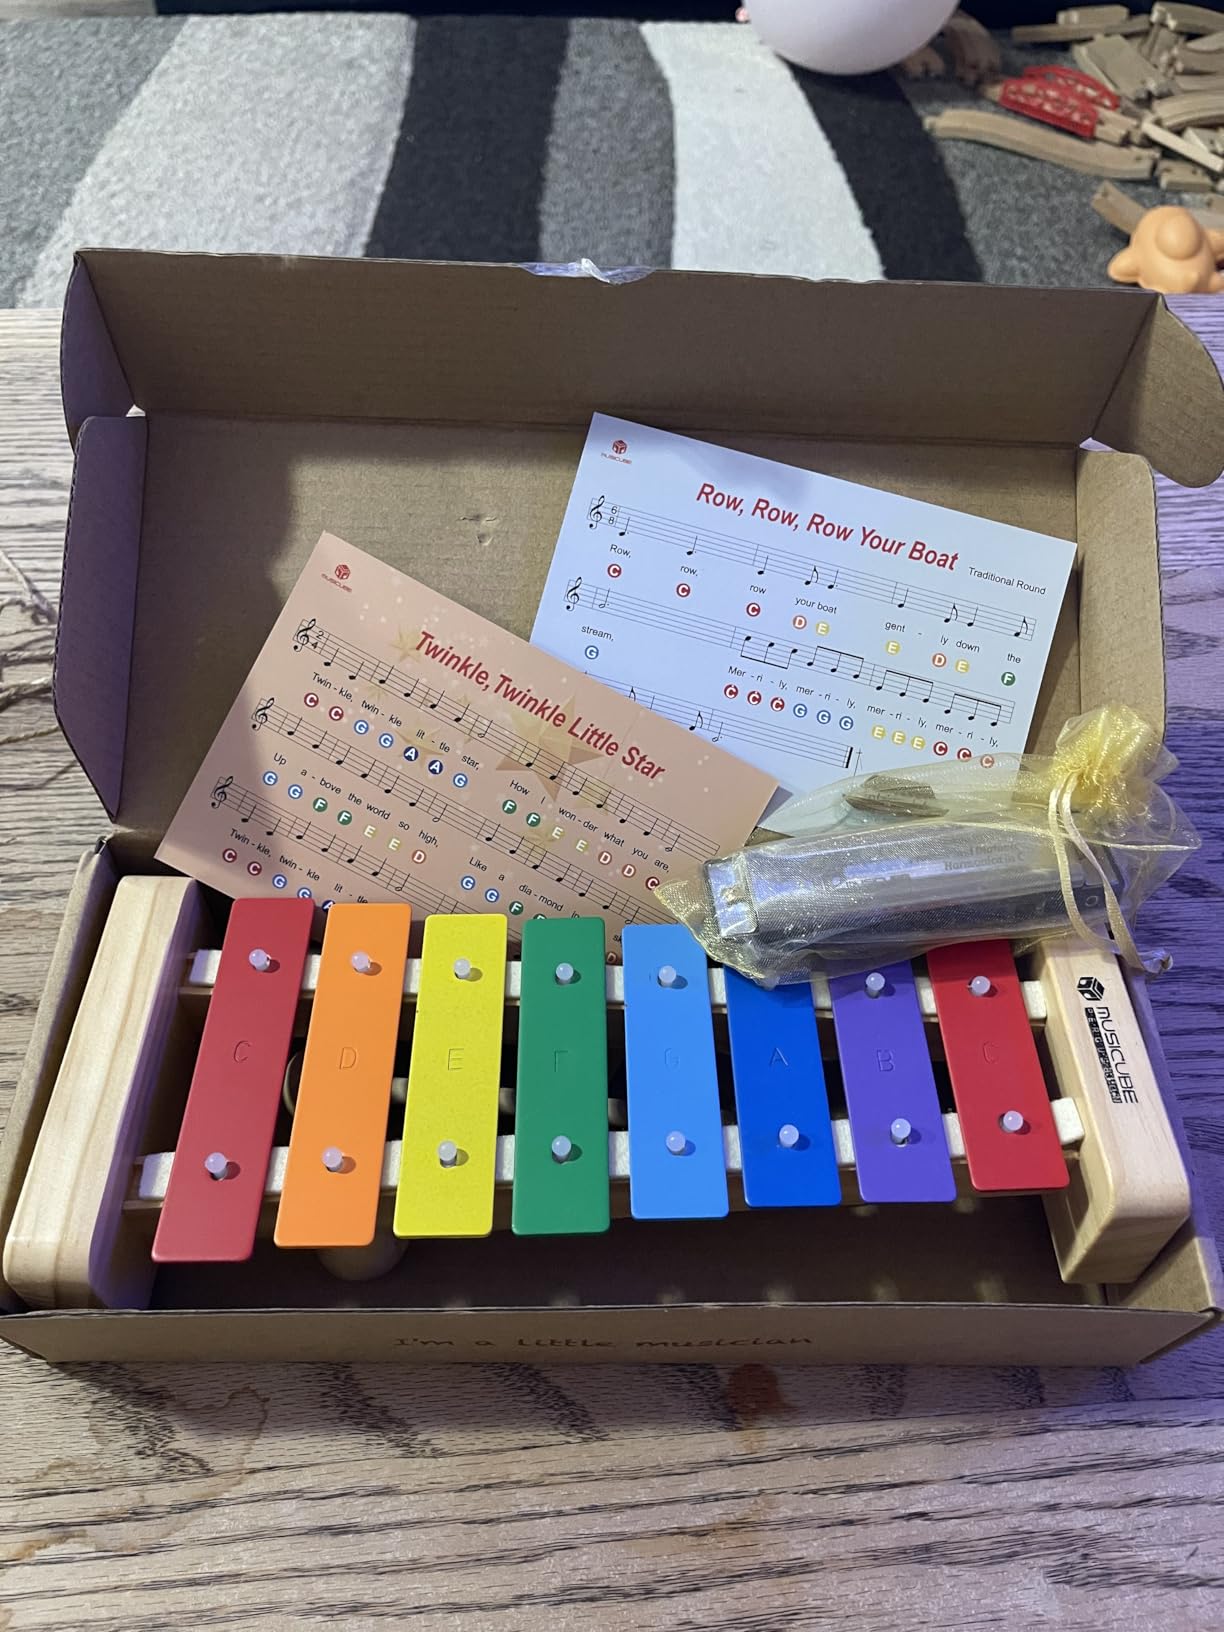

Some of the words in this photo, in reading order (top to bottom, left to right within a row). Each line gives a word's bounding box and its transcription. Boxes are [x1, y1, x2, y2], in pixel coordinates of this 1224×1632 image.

[696, 482, 744, 516] Row,
[751, 498, 799, 532] Row,
[806, 513, 853, 541] Row
[859, 526, 906, 556] Your
[908, 540, 959, 571] Boat
[968, 566, 1015, 587] Traditional
[1016, 579, 1046, 595] Round
[608, 565, 620, 577] C
[677, 584, 689, 596] C
[747, 604, 759, 616] C
[794, 616, 806, 628] D
[816, 622, 828, 634] E
[887, 642, 899, 654] E
[933, 654, 945, 666] D
[956, 660, 968, 672] E
[1002, 673, 1014, 685] F
[609, 544, 632, 558] Row,
[750, 584, 767, 594] row
[794, 597, 815, 610] your
[817, 602, 838, 614] boat
[885, 621, 905, 633] gent
[956, 639, 980, 653] down
[1006, 653, 1022, 664] the
[415, 630, 492, 693] Twinkle,
[494, 674, 566, 728] Twinkle
[568, 716, 619, 756] Little
[621, 746, 666, 780] Star
[580, 624, 614, 642] stream,
[728, 666, 746, 678] Mer
[796, 686, 814, 696] mer
[866, 704, 886, 716] mer
[936, 722, 954, 734] mer
[586, 646, 598, 658] G
[794, 705, 806, 717] G
[818, 711, 830, 723] G
[840, 717, 852, 729] G
[873, 727, 885, 739] E
[893, 732, 905, 744] E
[912, 737, 924, 749] E
[934, 743, 946, 755] C
[305, 694, 317, 706] C
[330, 707, 342, 719] C
[355, 721, 367, 733] G
[380, 734, 392, 746] G
[405, 748, 417, 760] A
[430, 761, 442, 773] A
[454, 774, 466, 786] G
[504, 801, 516, 813] F
[527, 814, 539, 826] F
[552, 827, 564, 839] E
[576, 839, 588, 851] E
[599, 852, 611, 864] D
[623, 865, 635, 877] D
[312, 672, 332, 690] Twin
[361, 700, 380, 716] twin
[388, 714, 402, 728] kle
[461, 754, 480, 770] star,
[510, 780, 530, 796] How
[558, 807, 577, 822] won
[582, 820, 598, 833] der
[604, 831, 625, 848] what
[632, 847, 648, 860] you
[654, 860, 670, 873] are,
[224, 850, 236, 862] C
[249, 862, 261, 874] C
[274, 876, 286, 888] G
[230, 828, 250, 846] Twin
[279, 854, 298, 870] twin
[264, 772, 276, 784] G
[289, 786, 301, 798] G
[314, 798, 326, 810] F
[339, 812, 351, 824] F
[364, 825, 376, 837] E
[388, 838, 400, 850] E
[413, 851, 425, 863] D
[462, 877, 474, 889] G
[486, 889, 498, 901] G
[510, 902, 522, 914] F
[273, 752, 287, 766] Up
[300, 768, 308, 777] a
[320, 778, 342, 794] bove
[348, 792, 362, 806] the
[366, 803, 390, 820] world
[398, 821, 410, 831] so
[418, 830, 438, 848] high,
[469, 856, 488, 872] Like
[498, 873, 505, 881] a
[518, 883, 532, 896] dia
[538, 894, 564, 912] mond
[233, 1040, 253, 1064] C
[339, 1046, 360, 1070] D
[446, 1048, 465, 1071] E
[769, 1047, 790, 1068] A
[876, 1049, 895, 1073] B
[1096, 1006, 1138, 1104] MUSICUBE
[636, 1337, 813, 1348] musician
